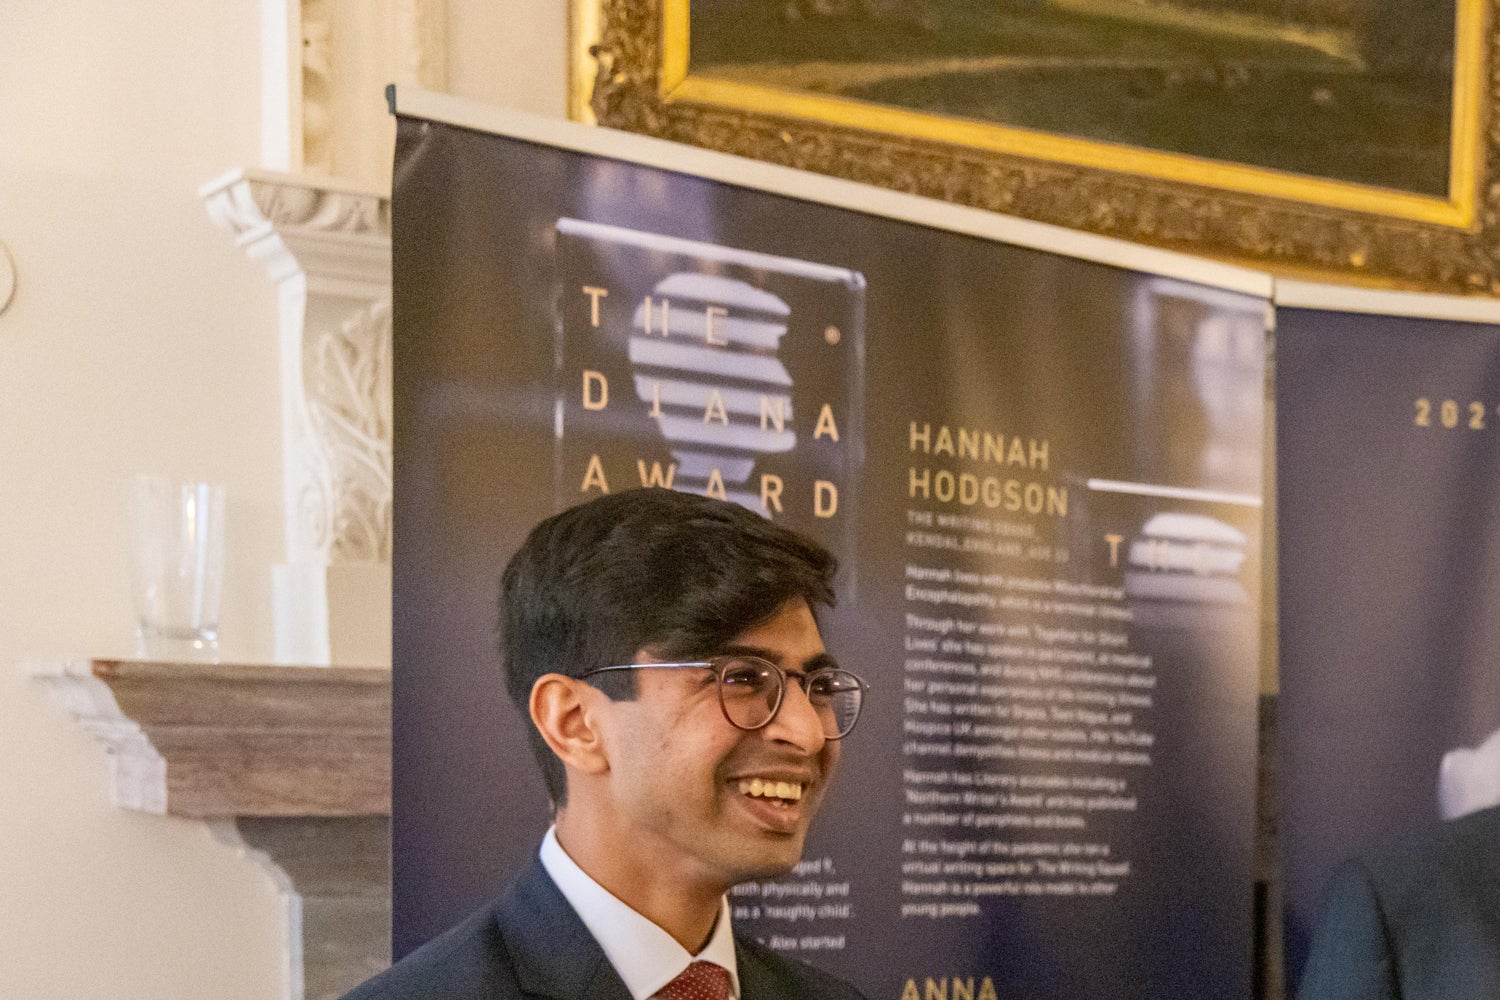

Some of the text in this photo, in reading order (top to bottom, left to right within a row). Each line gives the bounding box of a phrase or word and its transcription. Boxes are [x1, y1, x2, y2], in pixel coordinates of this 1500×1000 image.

[581, 284, 730, 347] THE
[581, 369, 840, 443] DIANA
[908, 421, 1050, 470] HANNAH
[580, 453, 839, 519] AWARD
[908, 466, 1069, 517] HODGSON
